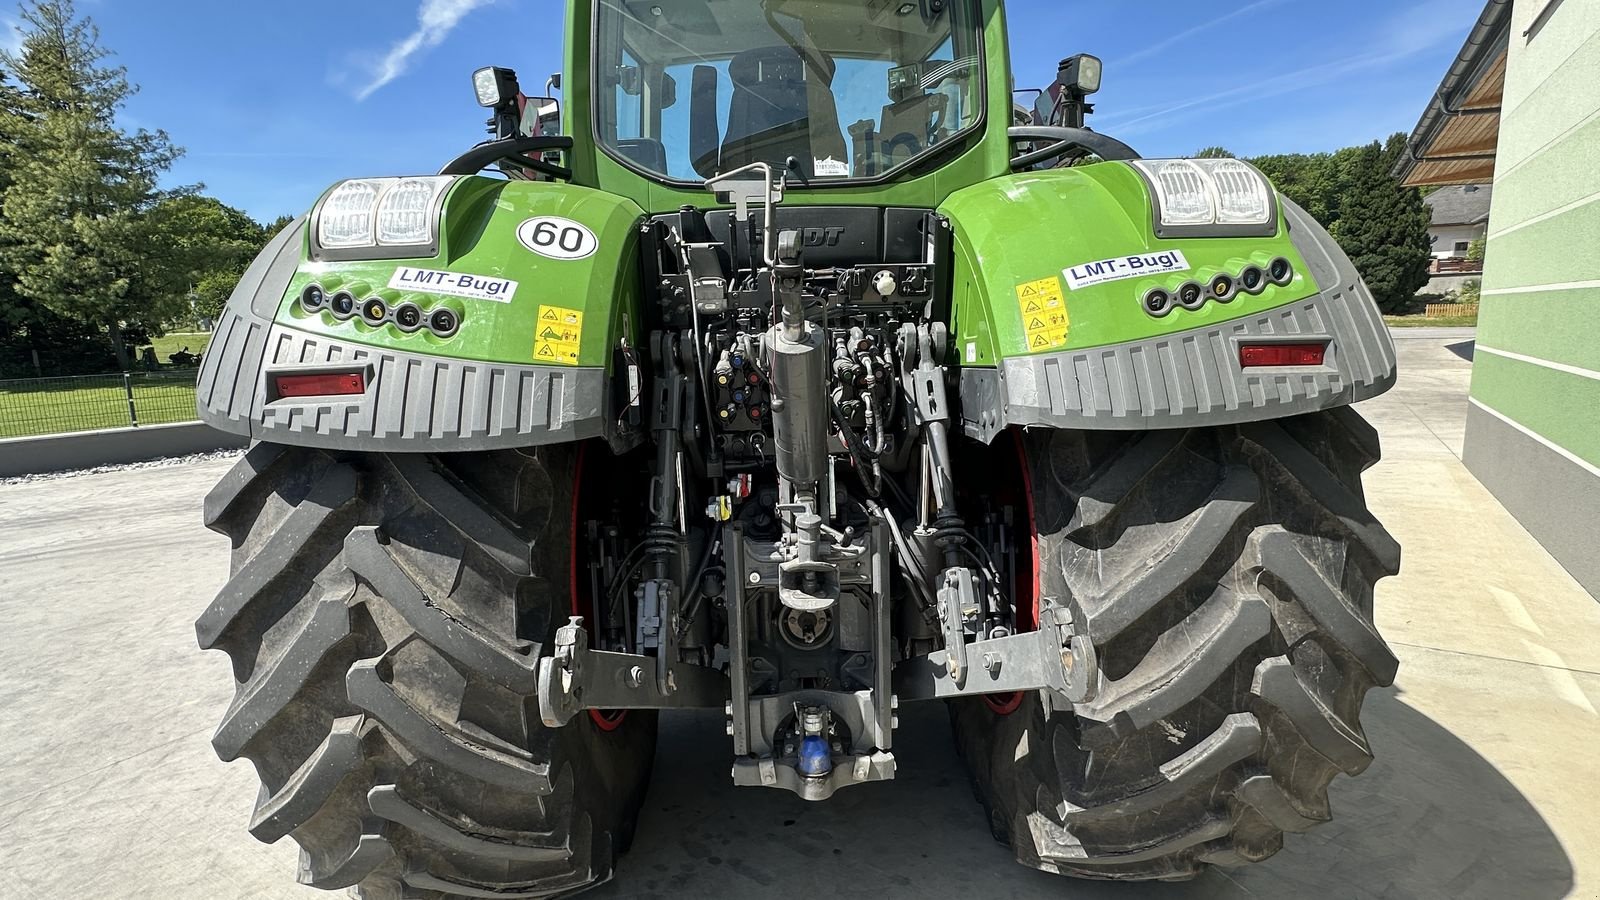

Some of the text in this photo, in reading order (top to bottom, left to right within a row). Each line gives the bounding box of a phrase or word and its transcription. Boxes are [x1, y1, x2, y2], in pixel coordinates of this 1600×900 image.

[532, 221, 584, 253] 60
[1071, 251, 1179, 281] LMT-Bugl
[400, 269, 510, 295] LMT-Bugl
